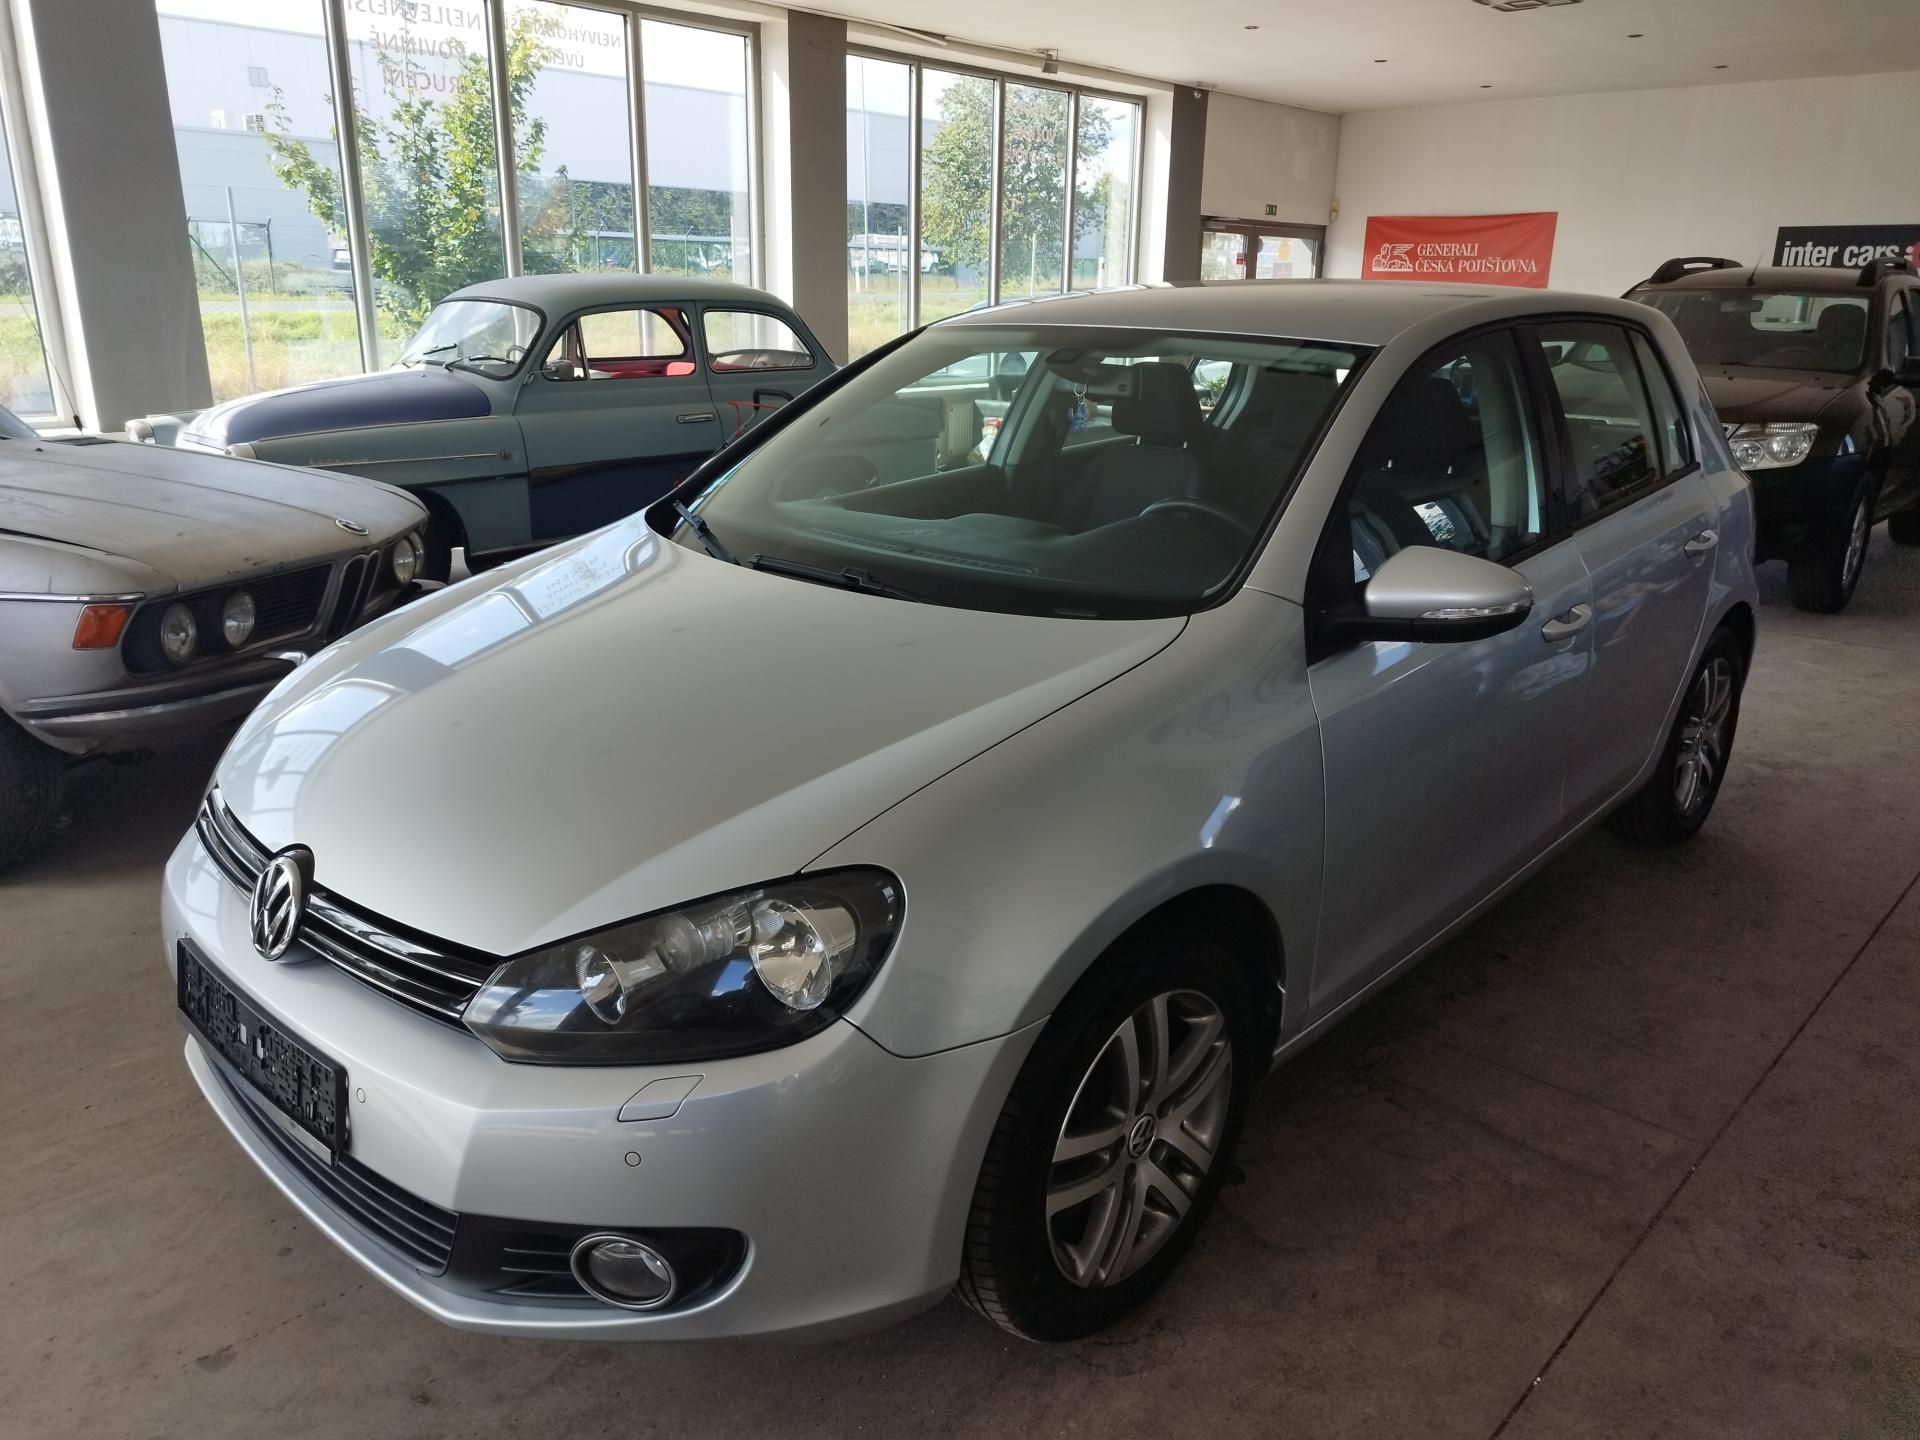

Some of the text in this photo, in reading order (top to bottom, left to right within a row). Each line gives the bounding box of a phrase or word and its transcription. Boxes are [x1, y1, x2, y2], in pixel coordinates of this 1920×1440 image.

[1417, 243, 1479, 257] GENERALI
[1781, 241, 1900, 267] inter cars
[1415, 257, 1537, 273] ČESKÁ POJIŠŤOVNA
